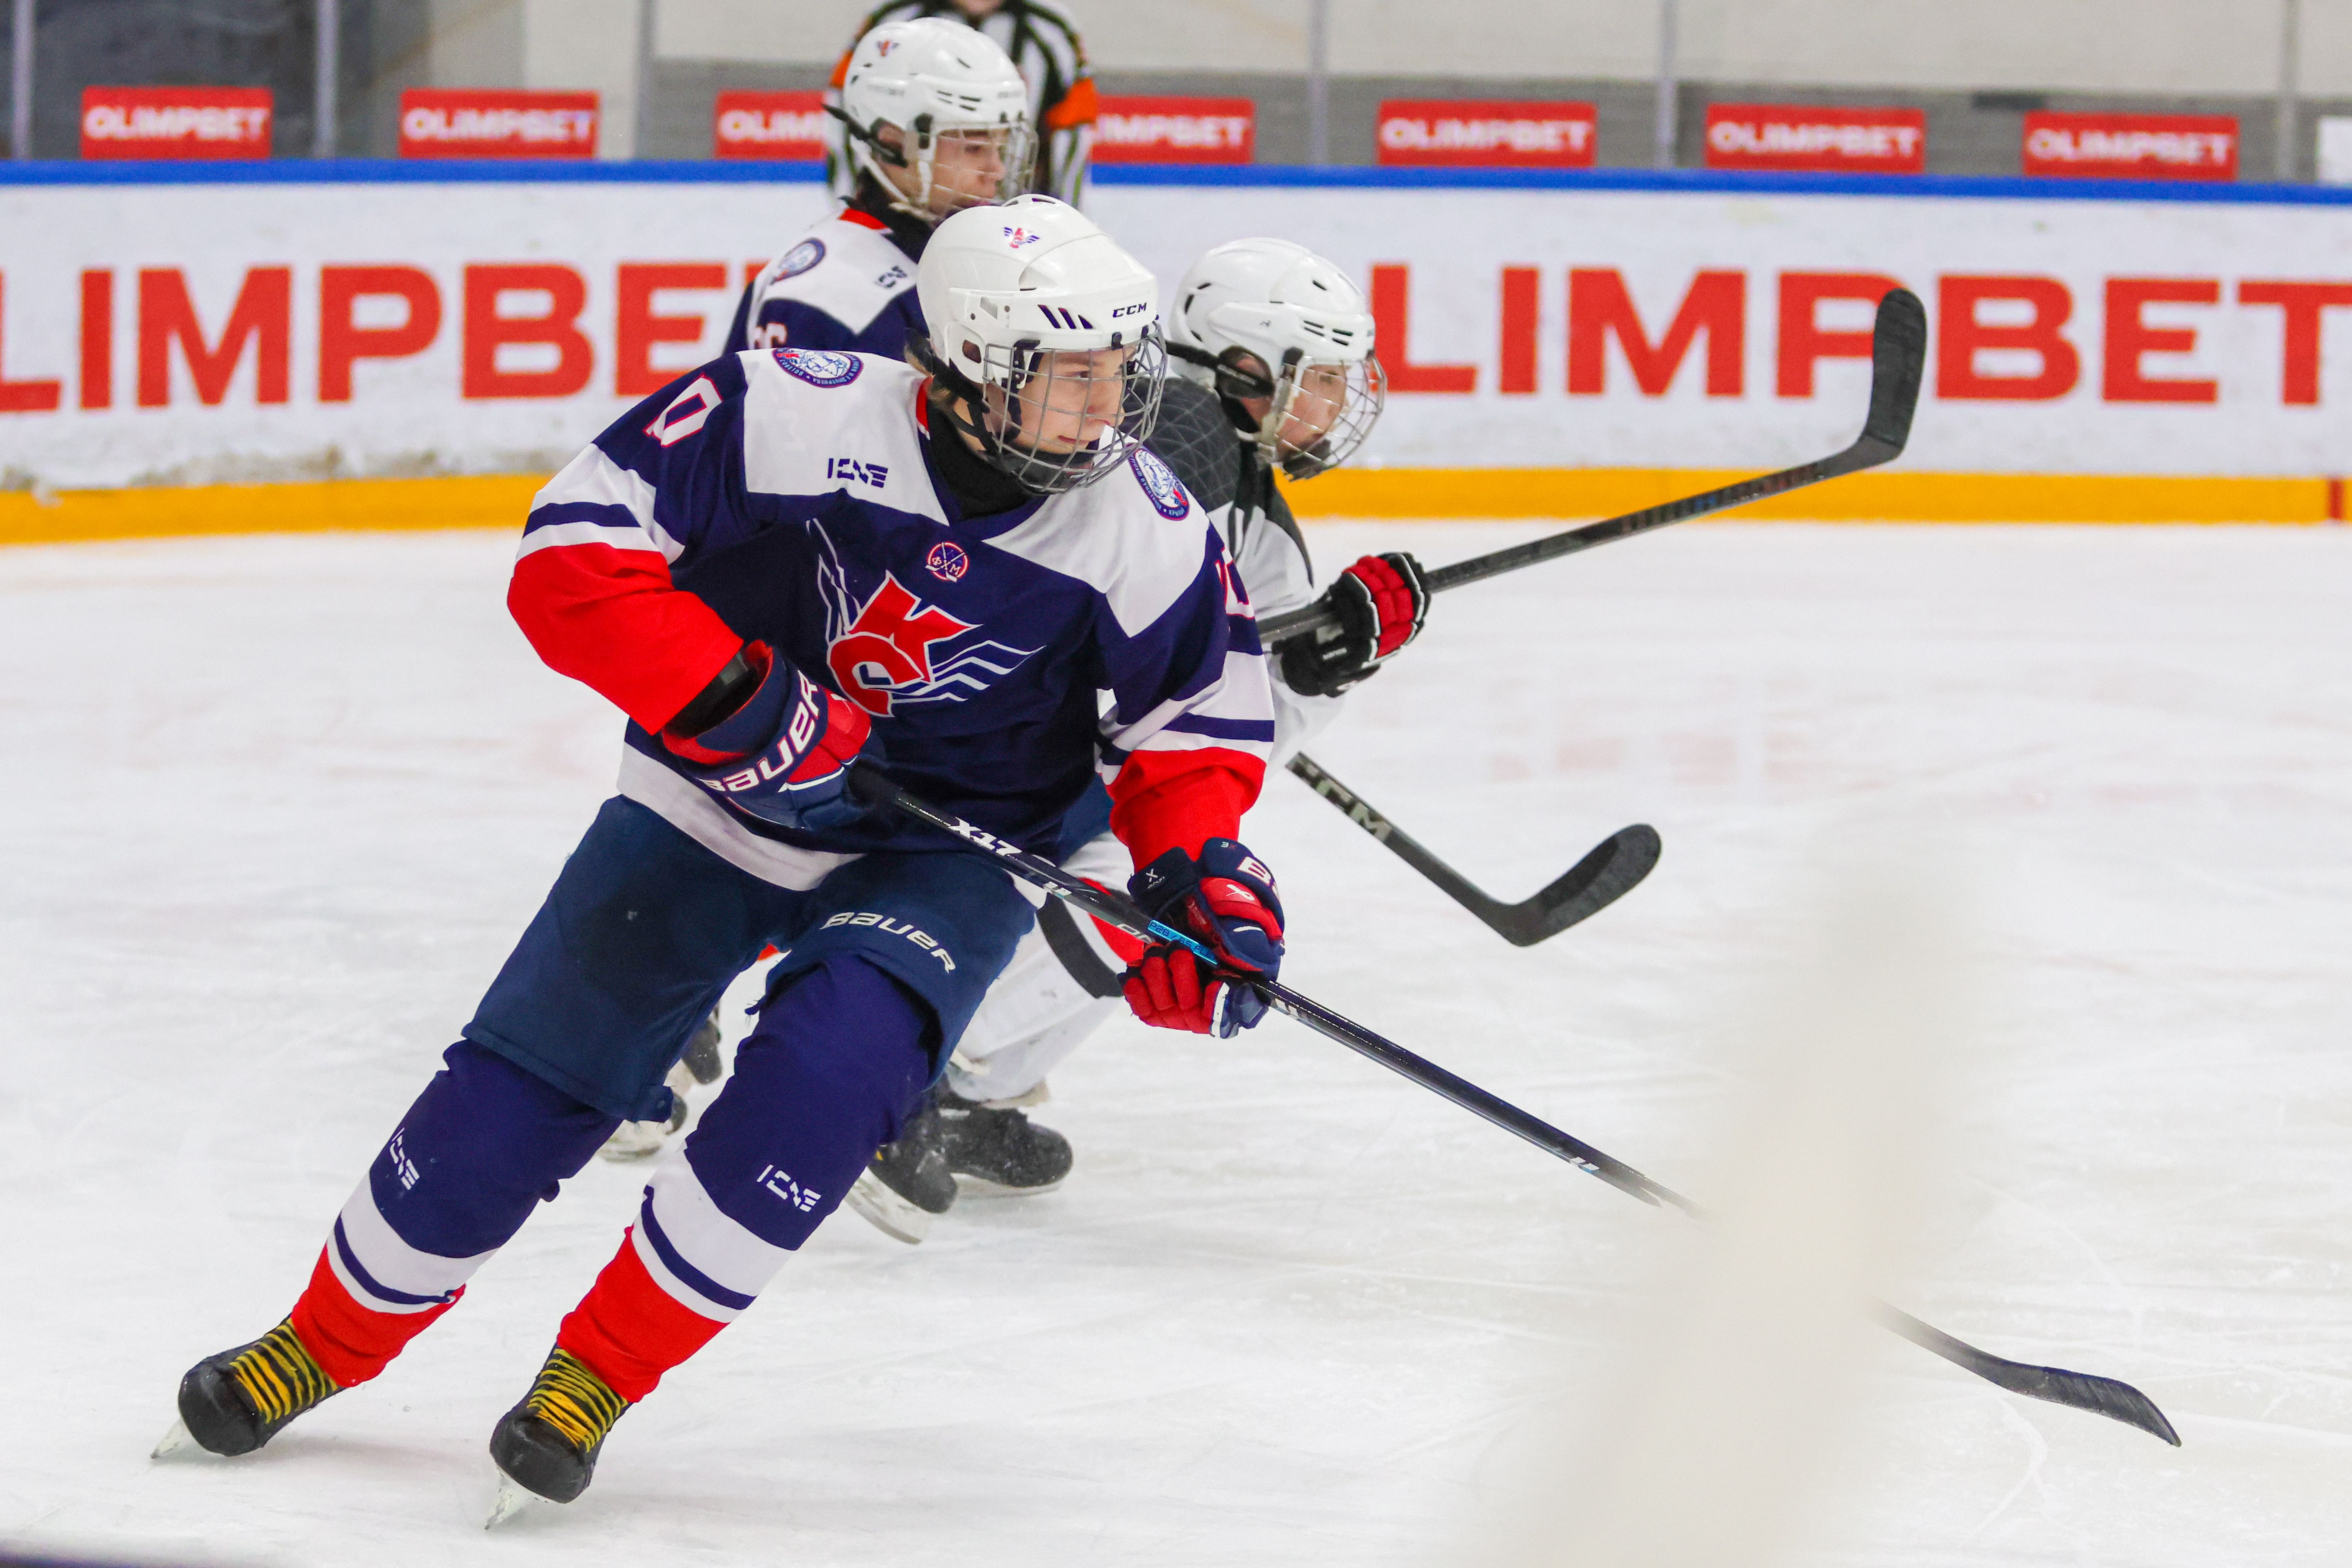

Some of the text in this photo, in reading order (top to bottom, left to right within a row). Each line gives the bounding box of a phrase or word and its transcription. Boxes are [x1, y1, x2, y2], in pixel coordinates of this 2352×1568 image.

[85, 105, 269, 141] OLIMPBET
[404, 107, 590, 141] OLIMPBET
[719, 110, 823, 142] OLIM
[1093, 114, 1248, 146] IMPBET
[1382, 118, 1591, 151] OLIMPBET
[1710, 122, 1921, 157] OLIMPBET
[2029, 128, 2231, 165] OLIMPBET
[1112, 302, 1147, 318] CCM
[0, 261, 771, 413] IMPBE
[696, 669, 819, 792] BAUER
[948, 816, 1023, 856] X17
[820, 912, 956, 973] BAUER
[1150, 922, 1170, 936] P28
